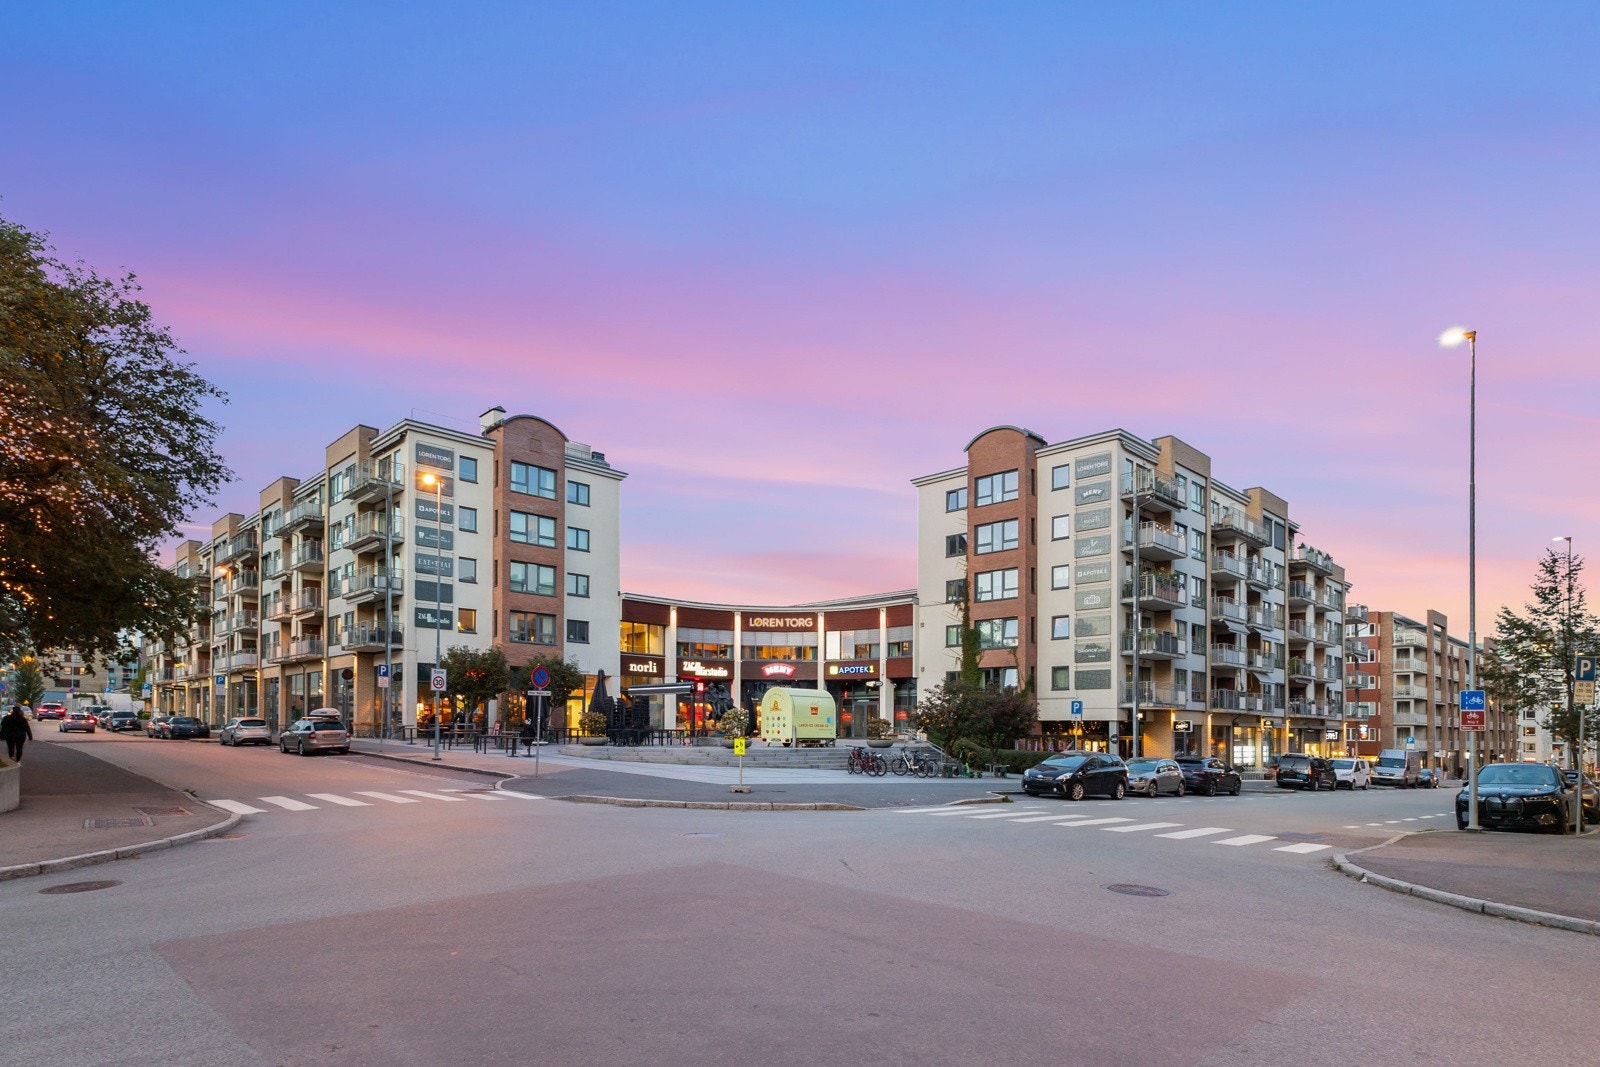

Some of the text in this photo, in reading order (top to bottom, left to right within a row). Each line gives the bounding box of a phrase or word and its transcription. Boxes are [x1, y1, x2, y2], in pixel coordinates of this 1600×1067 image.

[1082, 488, 1103, 498] MENY
[425, 506, 447, 515] APOEK
[1082, 569, 1103, 577] APOTEK
[749, 617, 813, 628] LØREN TORG
[380, 665, 387, 676] P
[629, 660, 658, 674] norli
[765, 664, 793, 676] MENY
[838, 665, 875, 674] APOTEK 1
[1580, 659, 1592, 679] P
[1073, 702, 1080, 713] P
